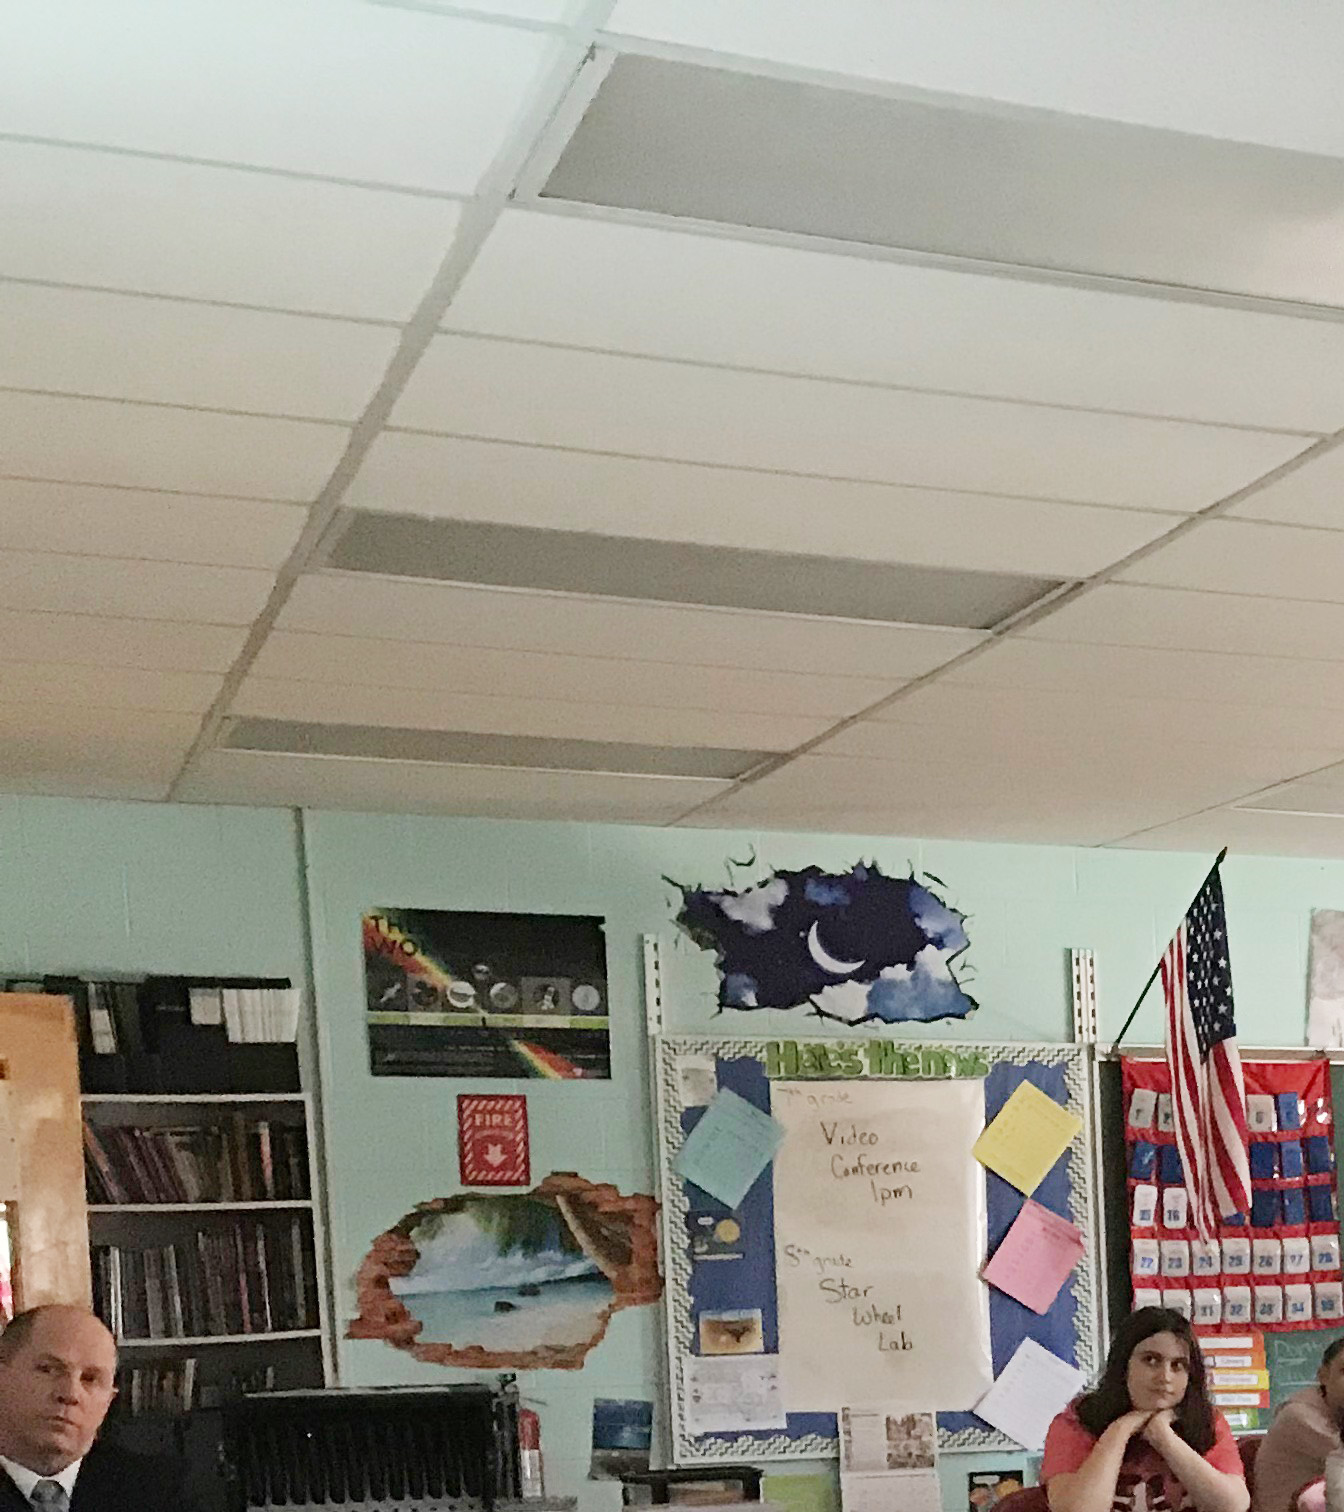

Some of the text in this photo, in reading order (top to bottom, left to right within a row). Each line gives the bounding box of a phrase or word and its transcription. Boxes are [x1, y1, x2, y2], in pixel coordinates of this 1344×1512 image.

[474, 1113, 513, 1127] FIRE
[819, 1120, 880, 1146] Video
[829, 1153, 922, 1180] Conference
[869, 1180, 914, 1208] 1pm
[818, 1278, 874, 1305] Star
[852, 1302, 902, 1327] Wheel
[878, 1331, 914, 1352] Lab
